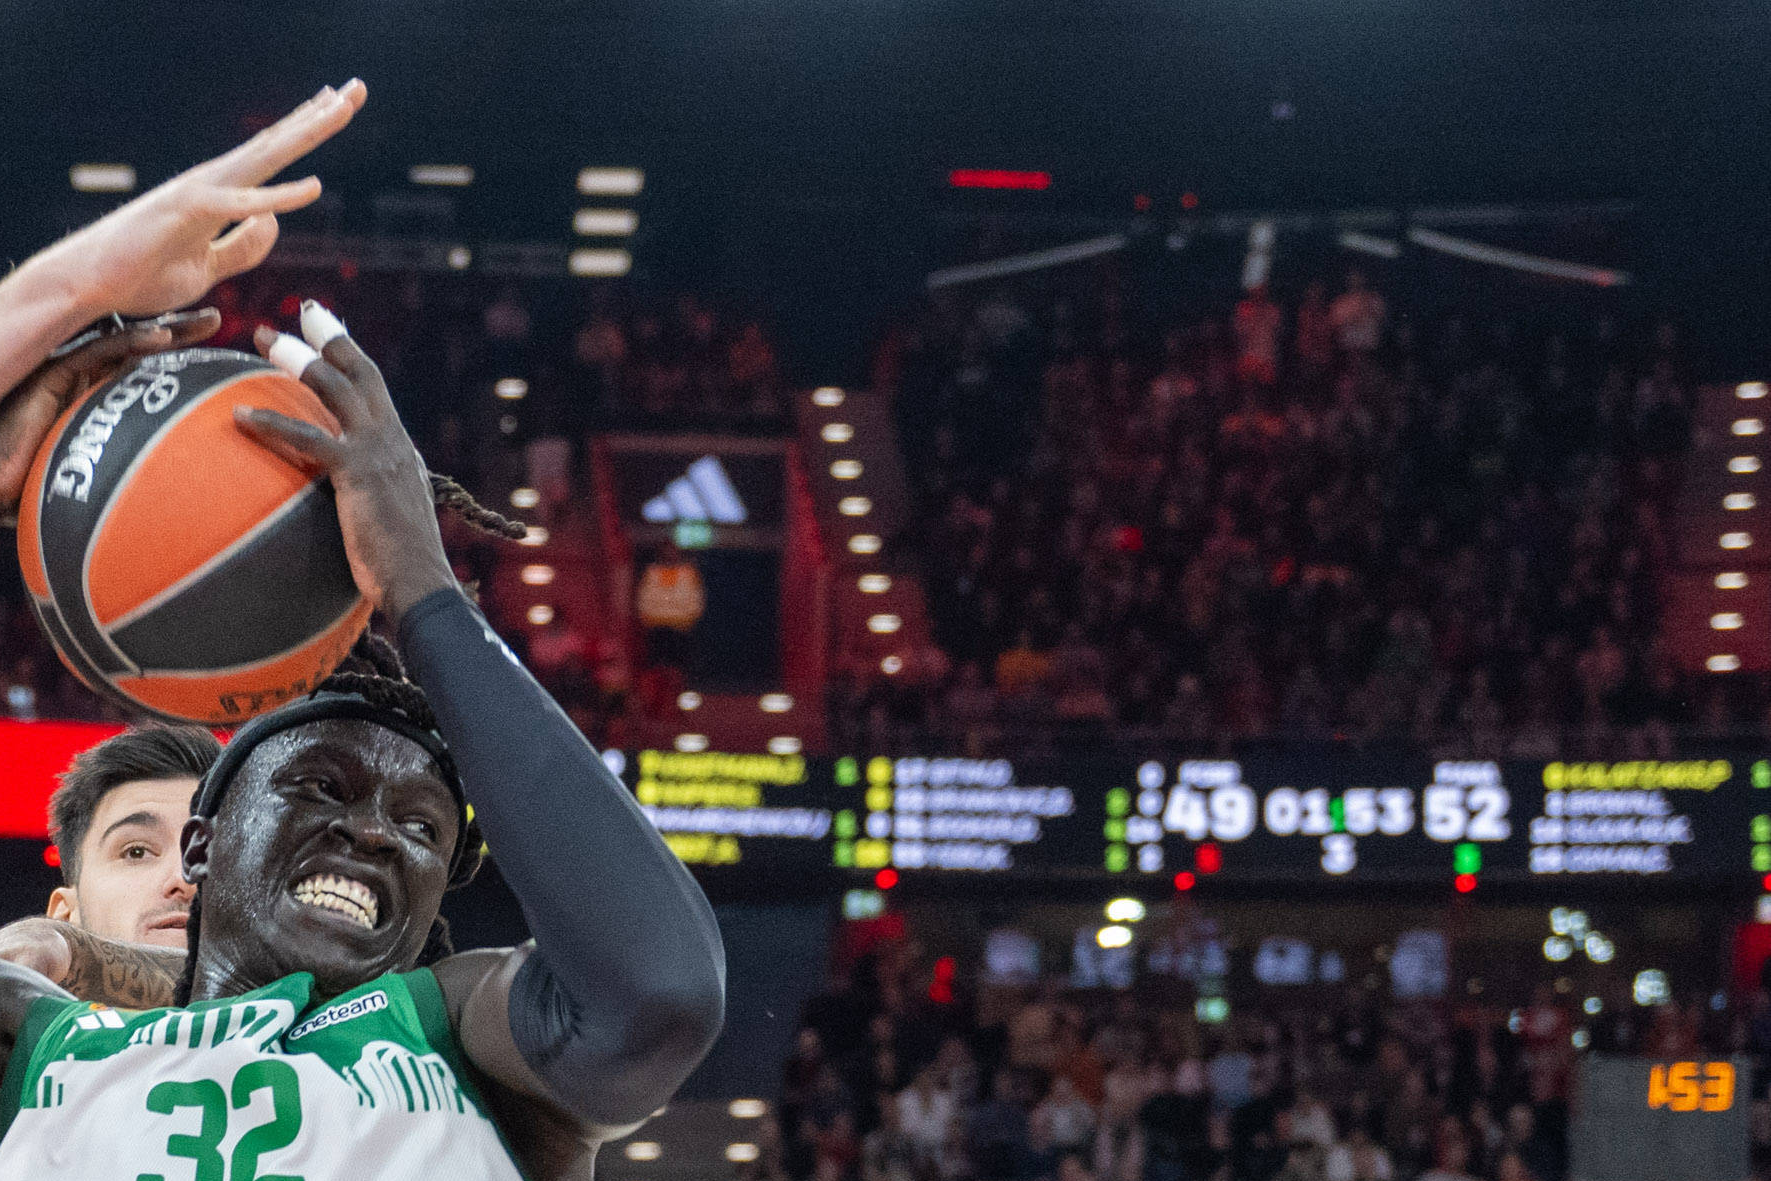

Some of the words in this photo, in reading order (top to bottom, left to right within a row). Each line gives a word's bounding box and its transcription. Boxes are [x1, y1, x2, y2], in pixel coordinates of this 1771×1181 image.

[1163, 783, 1256, 842] 49
[1423, 783, 1512, 841] 52
[291, 994, 386, 1038] oneteam
